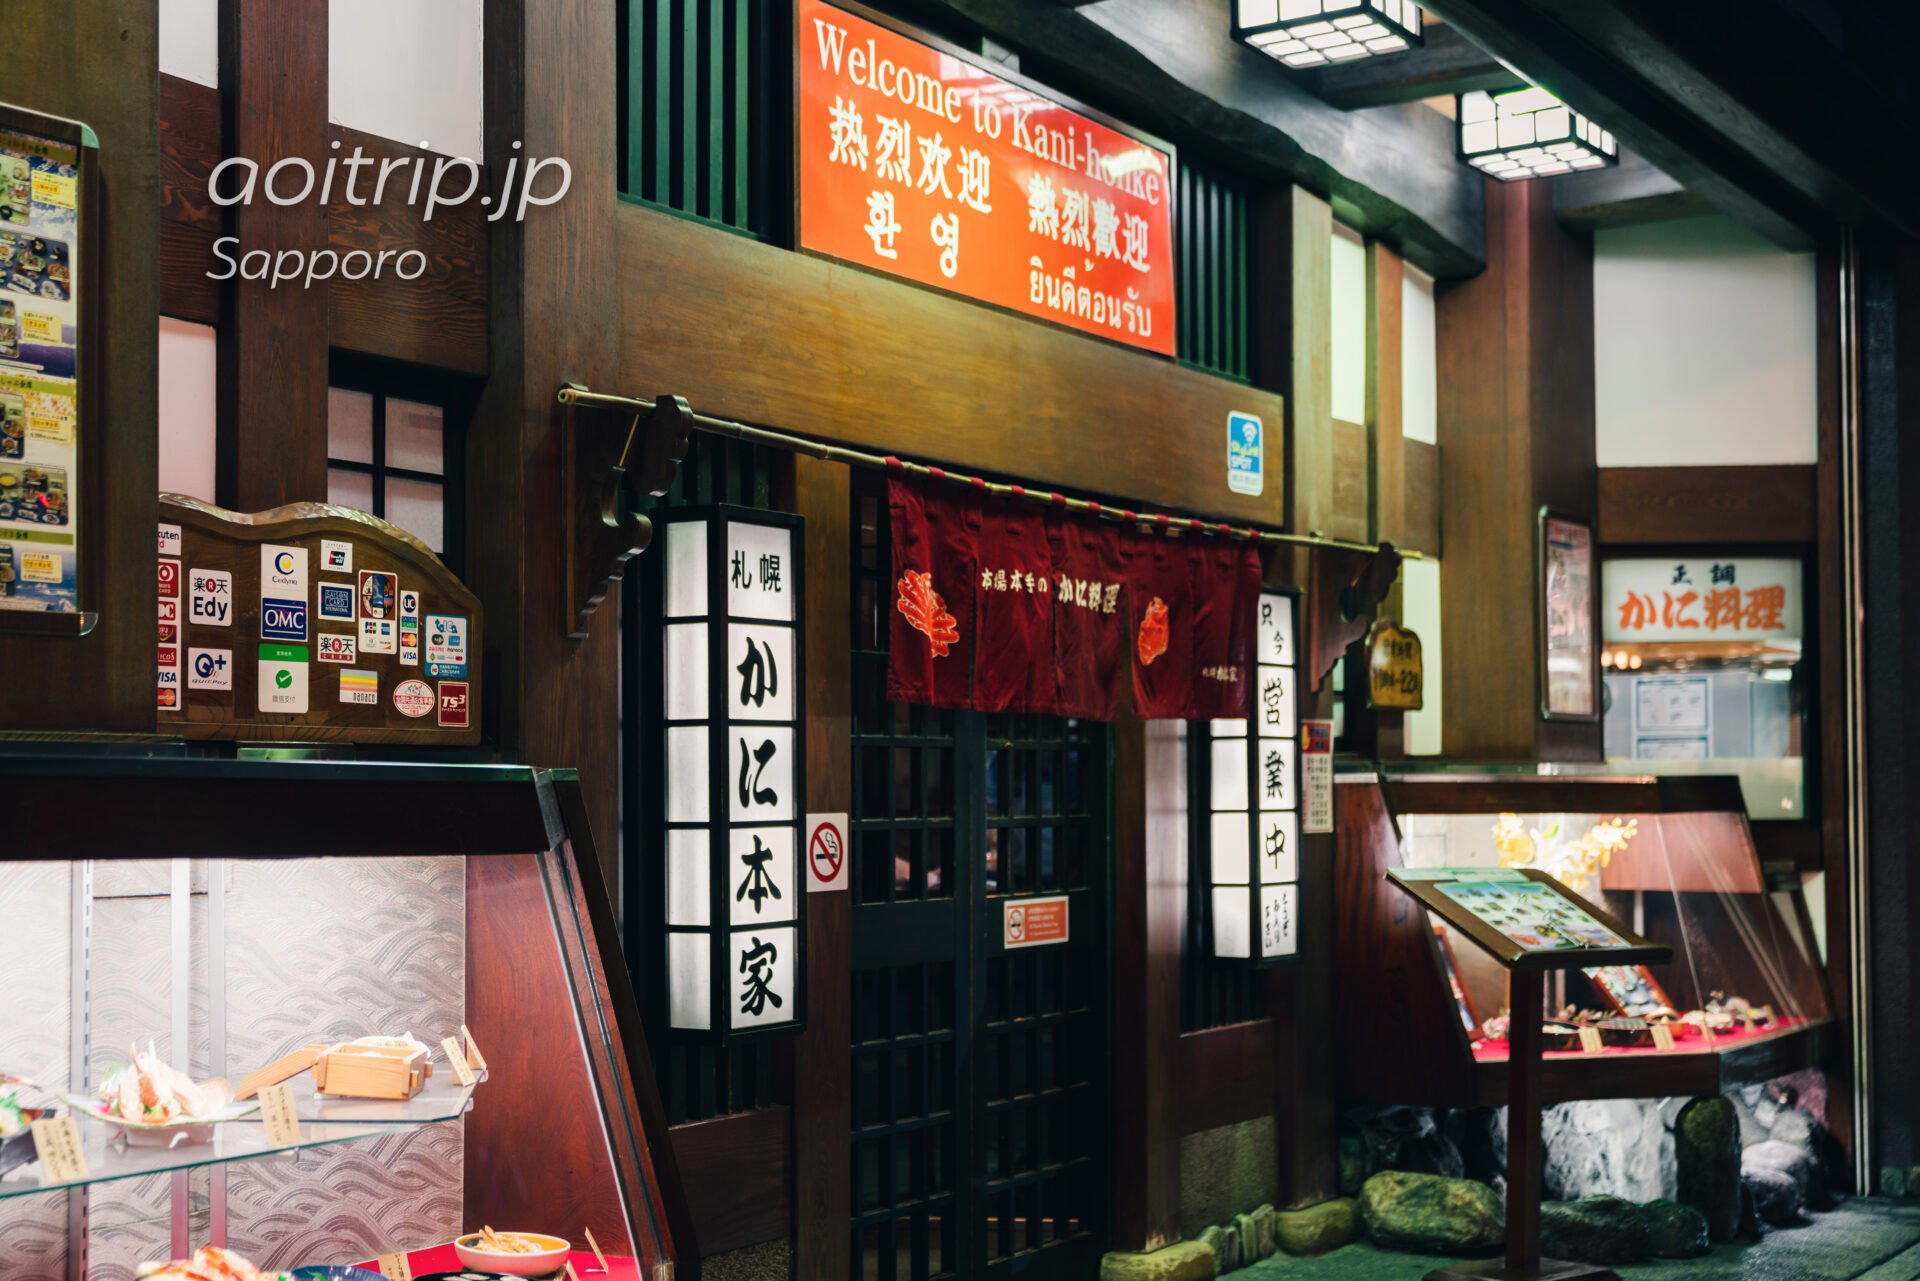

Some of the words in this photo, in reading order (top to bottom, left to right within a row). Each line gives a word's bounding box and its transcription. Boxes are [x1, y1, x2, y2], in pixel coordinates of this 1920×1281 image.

[813, 18, 962, 124] Welcome
[972, 90, 1002, 139] to
[1011, 107, 1160, 206] Kani-honke
[828, 95, 993, 215] 热烈欢迎
[730, 550, 782, 594] 札幌
[1671, 563, 1736, 586] 正調
[193, 596, 228, 622] Edy
[264, 609, 304, 629] OMC
[1617, 583, 1787, 631] かに料理
[402, 651, 417, 660] VISA
[735, 636, 784, 1017] かに本家
